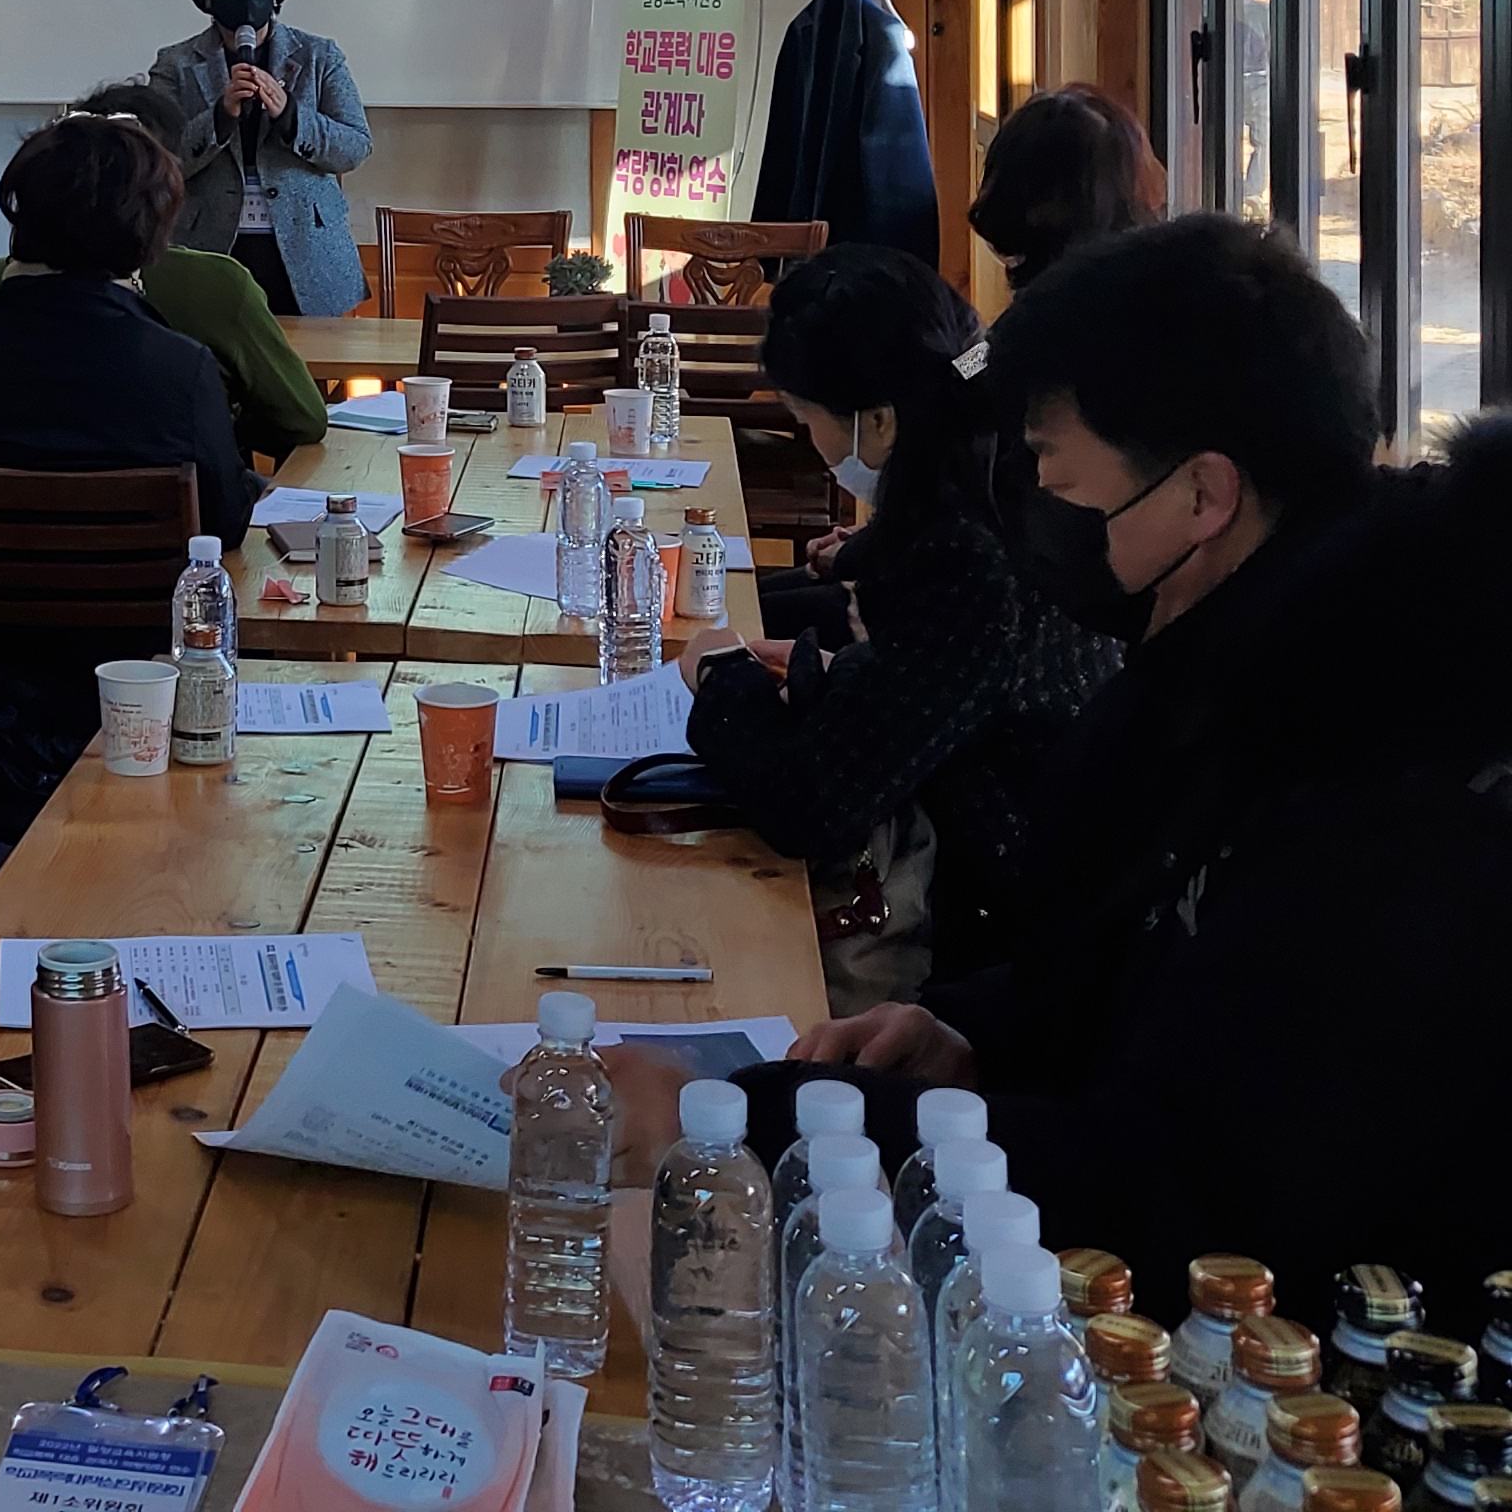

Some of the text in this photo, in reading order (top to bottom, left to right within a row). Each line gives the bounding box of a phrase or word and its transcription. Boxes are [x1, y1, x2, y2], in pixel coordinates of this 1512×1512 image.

[625, 29, 737, 80] 학교폭력 대응
[640, 91, 706, 138] 관계자
[615, 148, 728, 204] 역량강화 연수
[347, 1426, 467, 1469] 따뜻하게
[355, 1403, 475, 1450] 오늘 그대를
